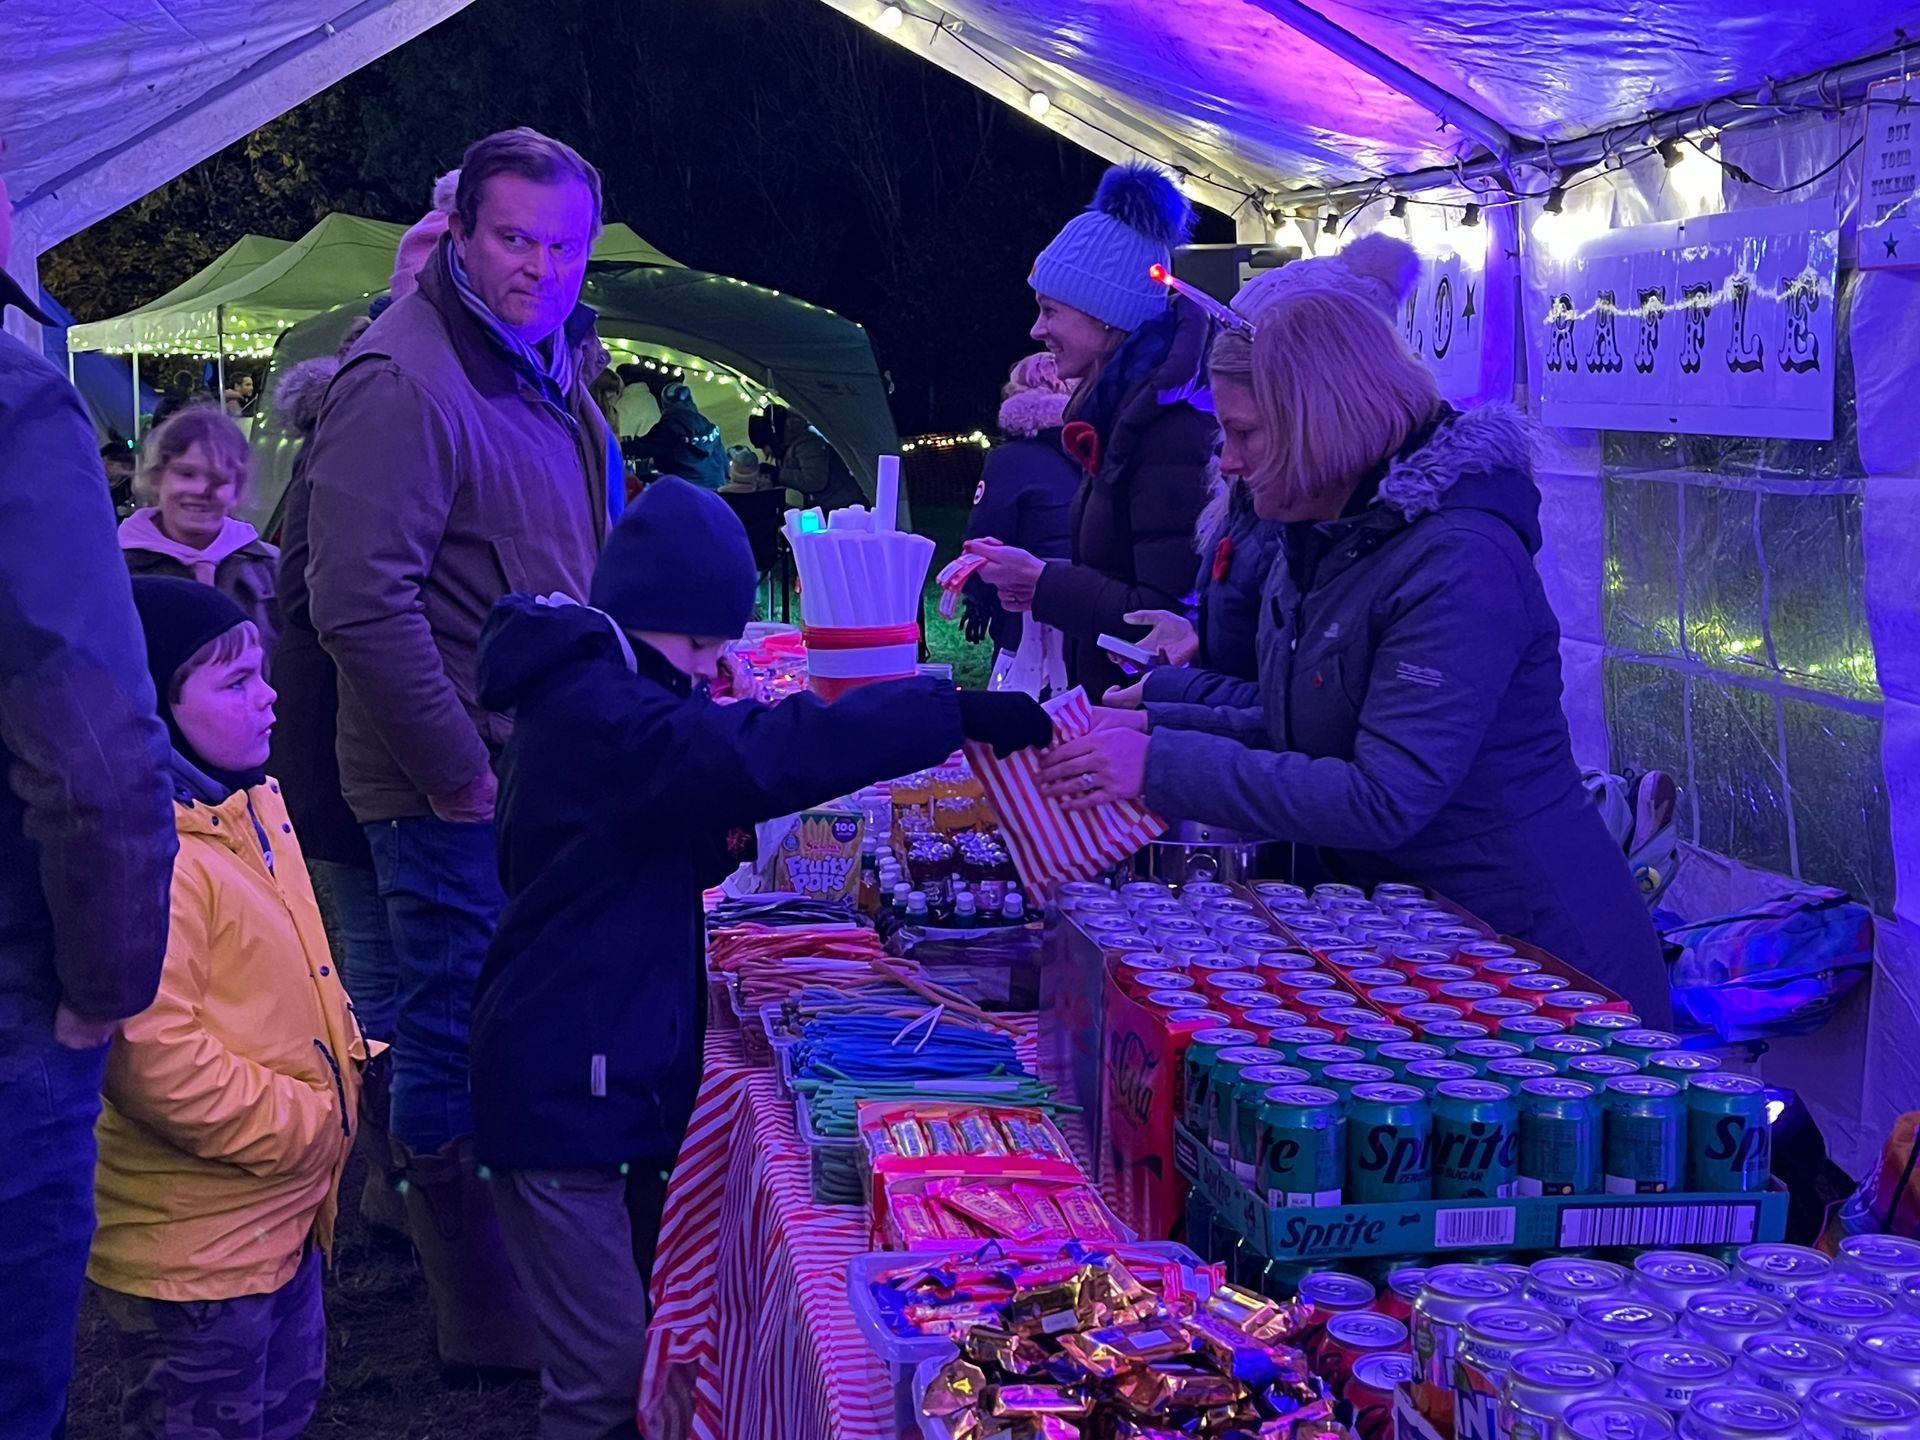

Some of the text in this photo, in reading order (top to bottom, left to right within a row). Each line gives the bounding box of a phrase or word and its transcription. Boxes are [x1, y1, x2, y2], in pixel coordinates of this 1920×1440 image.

[1884, 122, 1912, 144] BUY
[1880, 149, 1912, 170] YOUR
[1871, 174, 1916, 197] TOKENS
[1545, 275, 1822, 375] RAFFLE
[835, 822, 857, 833] 100
[785, 854, 854, 877] Fruity
[1280, 1212, 1386, 1256] Sprite
[1475, 1343, 1511, 1361] SUGAR
